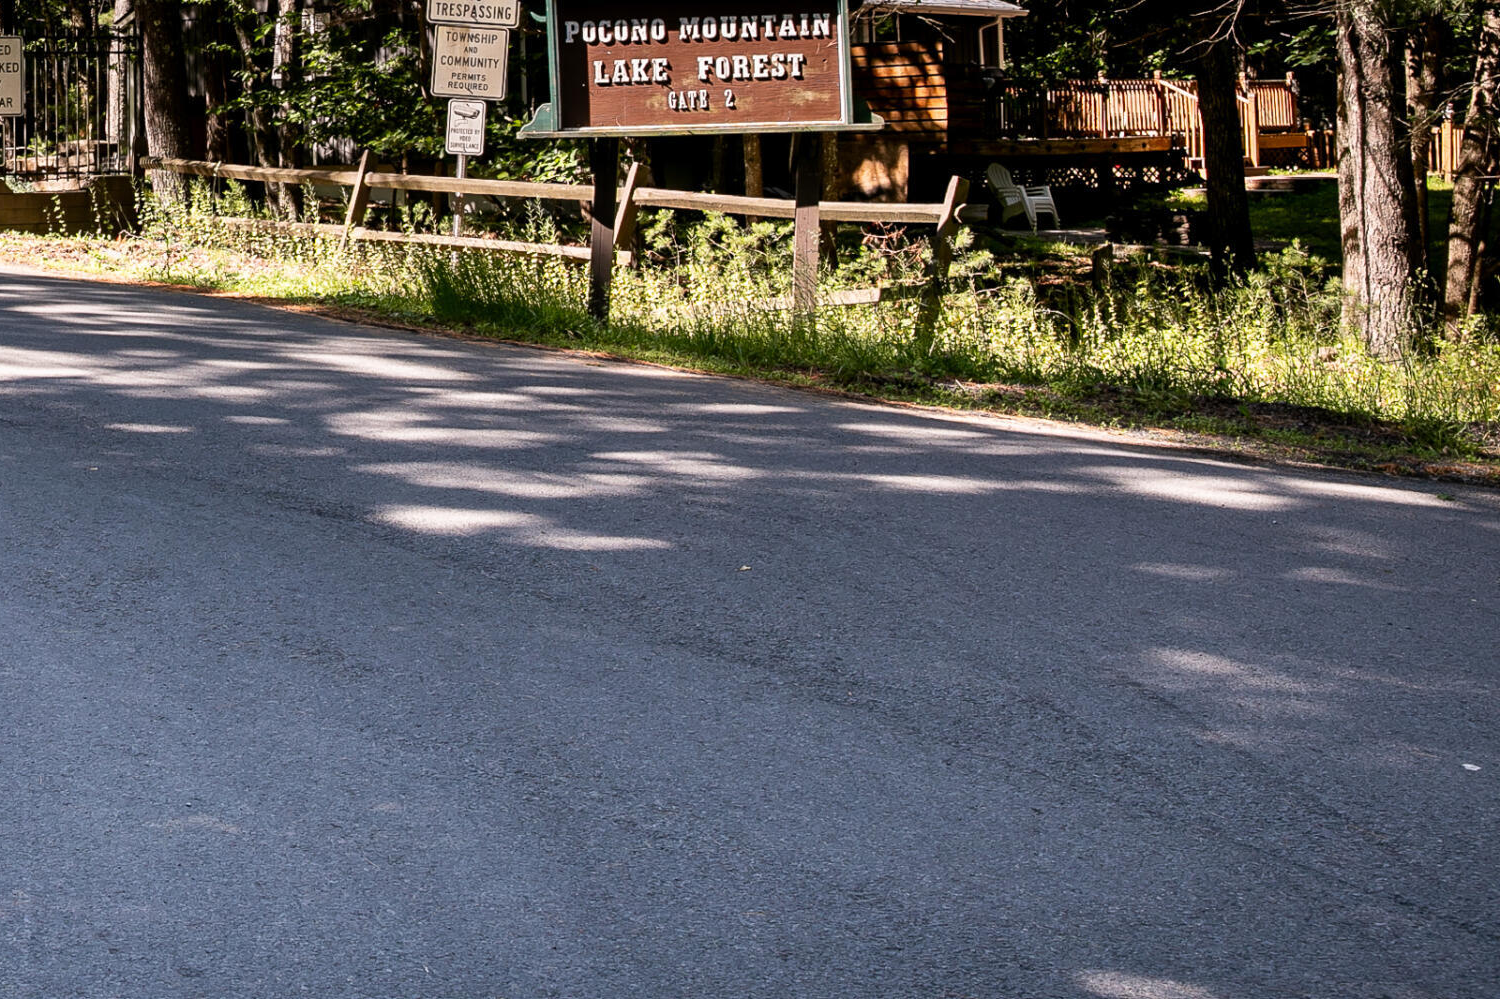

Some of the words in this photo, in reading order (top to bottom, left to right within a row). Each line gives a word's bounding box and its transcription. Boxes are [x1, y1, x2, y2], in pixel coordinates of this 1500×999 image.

[436, 2, 512, 20] TRESPASSING
[565, 18, 666, 43] POCONO
[679, 13, 831, 40] MOUNTAIN
[446, 31, 498, 44] TOWNSHIP
[440, 55, 499, 68] COMMUNITY
[593, 58, 668, 84] LAKE
[697, 53, 804, 80] FOREST
[451, 72, 486, 81] PERMITS
[448, 81, 488, 91] REQUIRED
[724, 89, 734, 107] 2
